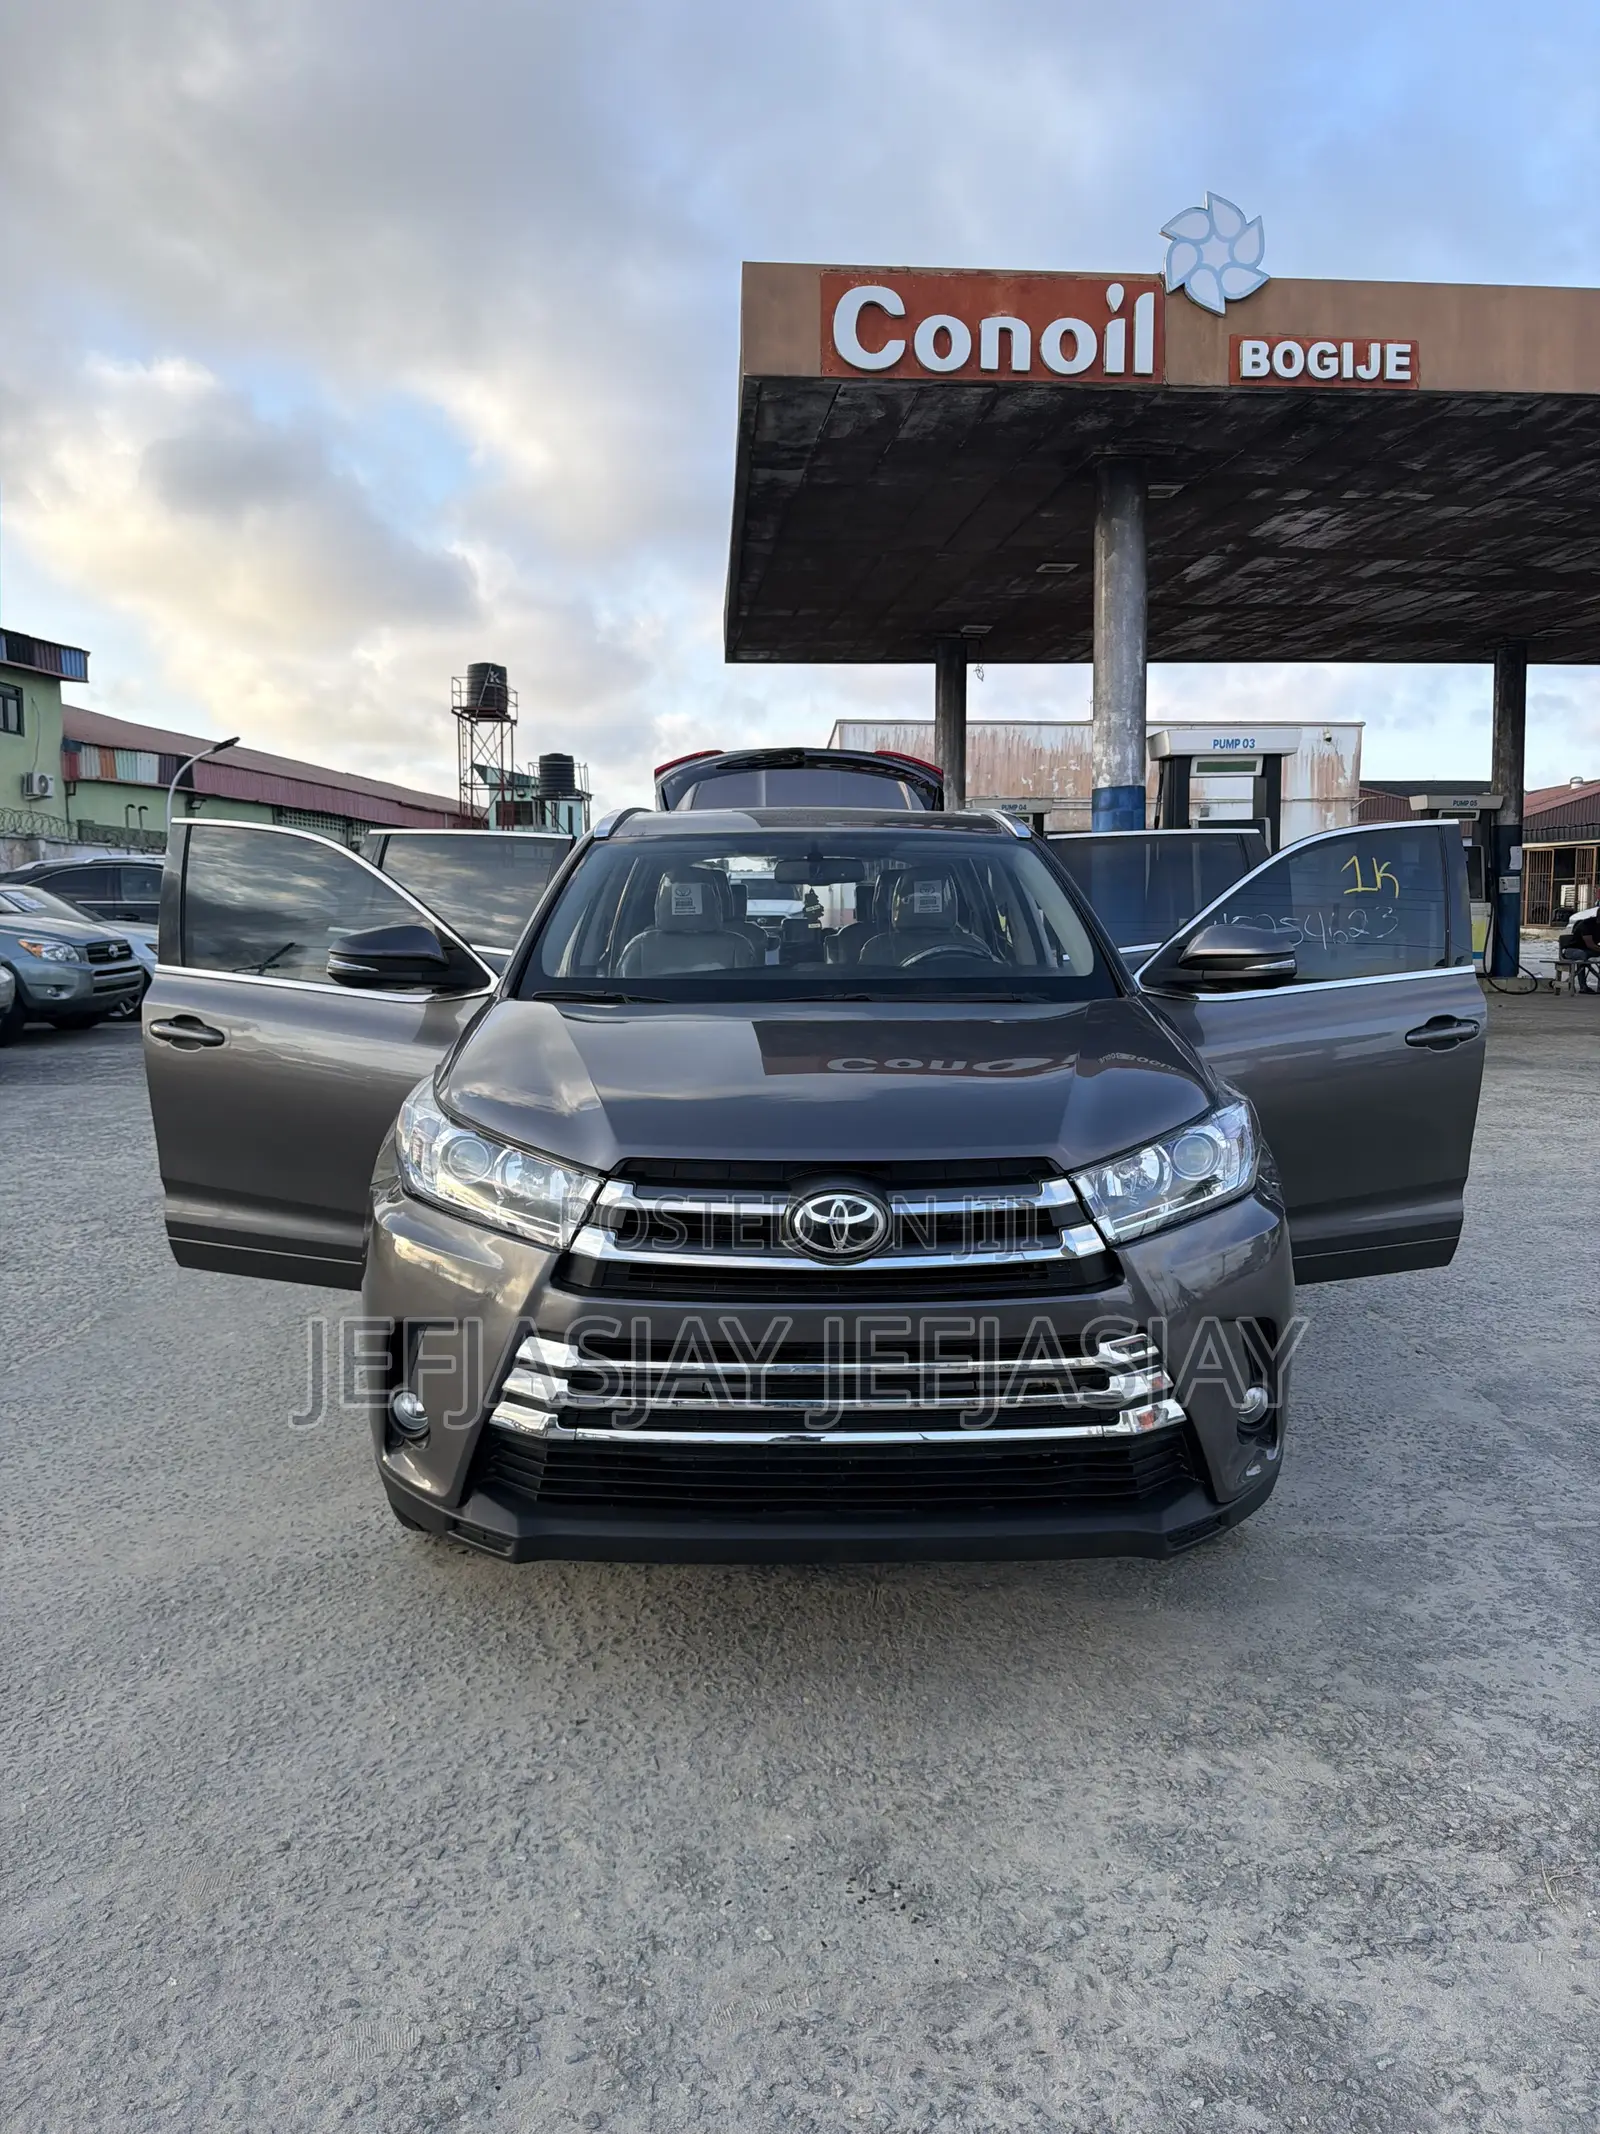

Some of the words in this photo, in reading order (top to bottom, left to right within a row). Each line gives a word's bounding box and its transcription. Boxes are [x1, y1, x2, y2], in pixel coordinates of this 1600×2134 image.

[832, 283, 1155, 377] Conoil
[1239, 338, 1413, 382] BOGIJE
[1212, 738, 1241, 750] PUMP
[1242, 738, 1256, 749] 03
